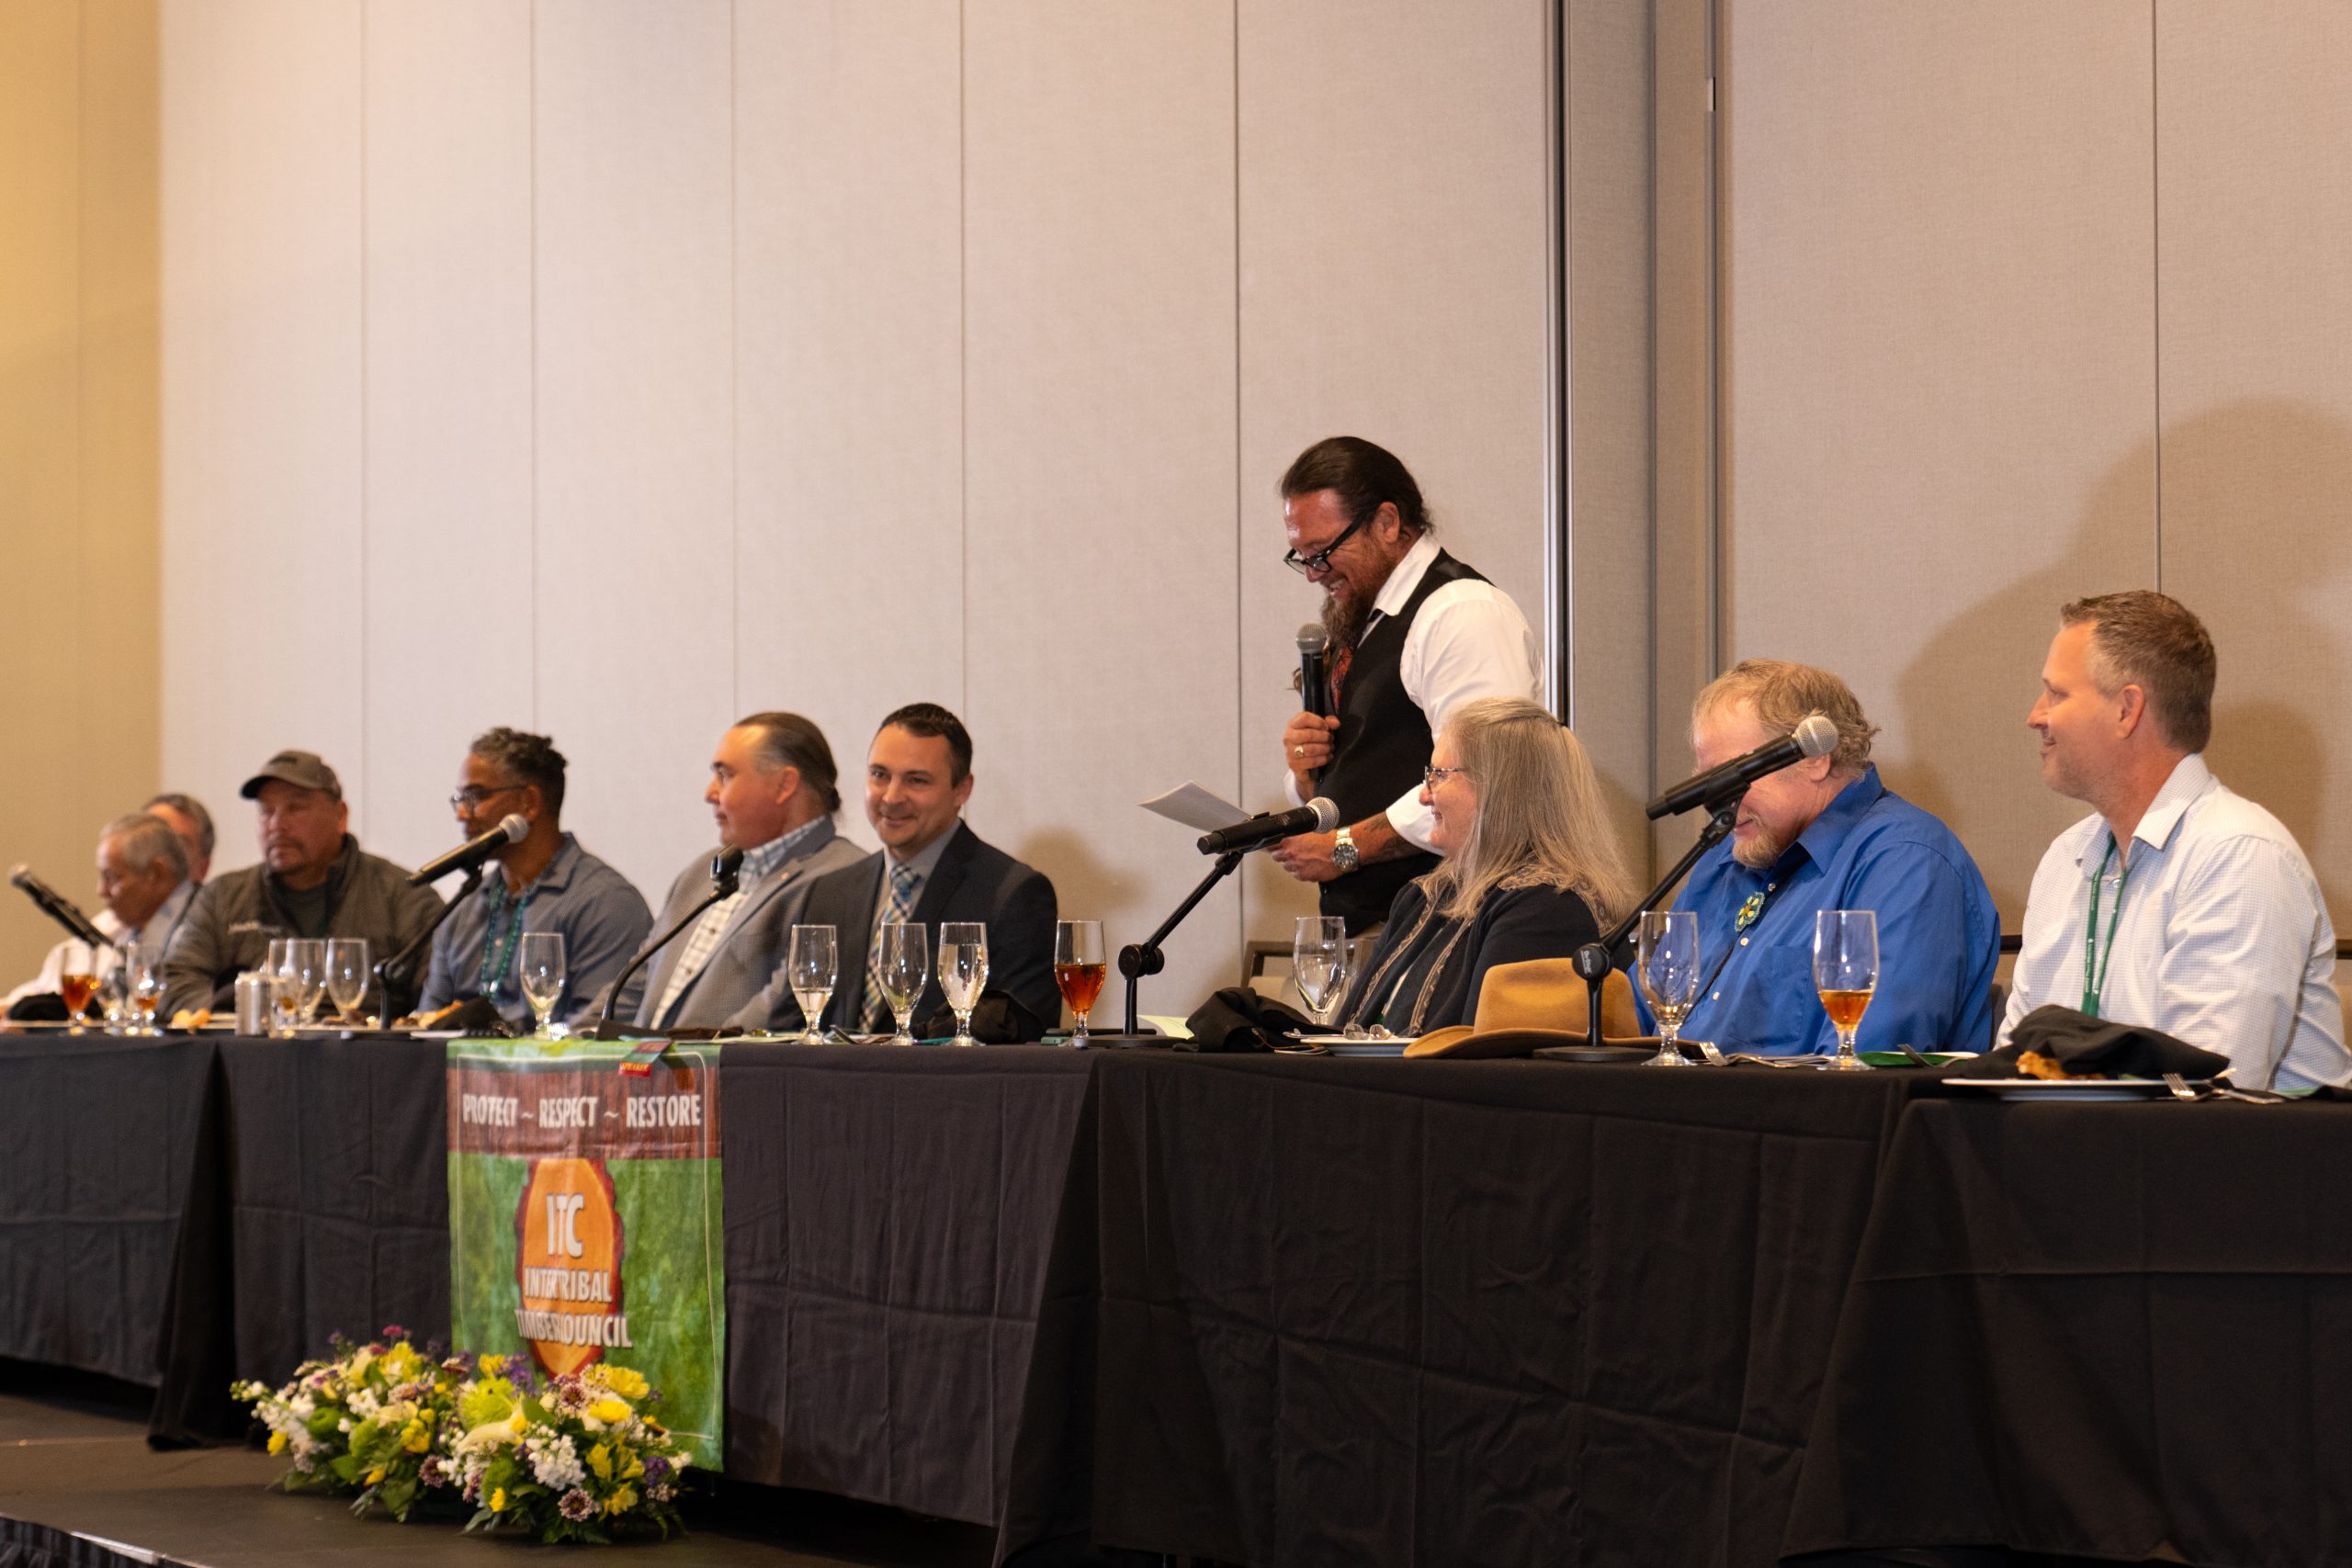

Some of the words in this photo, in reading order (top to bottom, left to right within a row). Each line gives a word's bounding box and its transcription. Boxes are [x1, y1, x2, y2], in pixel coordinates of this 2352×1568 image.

[463, 1093, 518, 1127] PROTECT
[539, 1096, 598, 1128] RESPECT
[626, 1094, 701, 1129] RESTORE
[546, 1193, 585, 1258] ITC
[561, 1313, 632, 1348] OUNCIL
